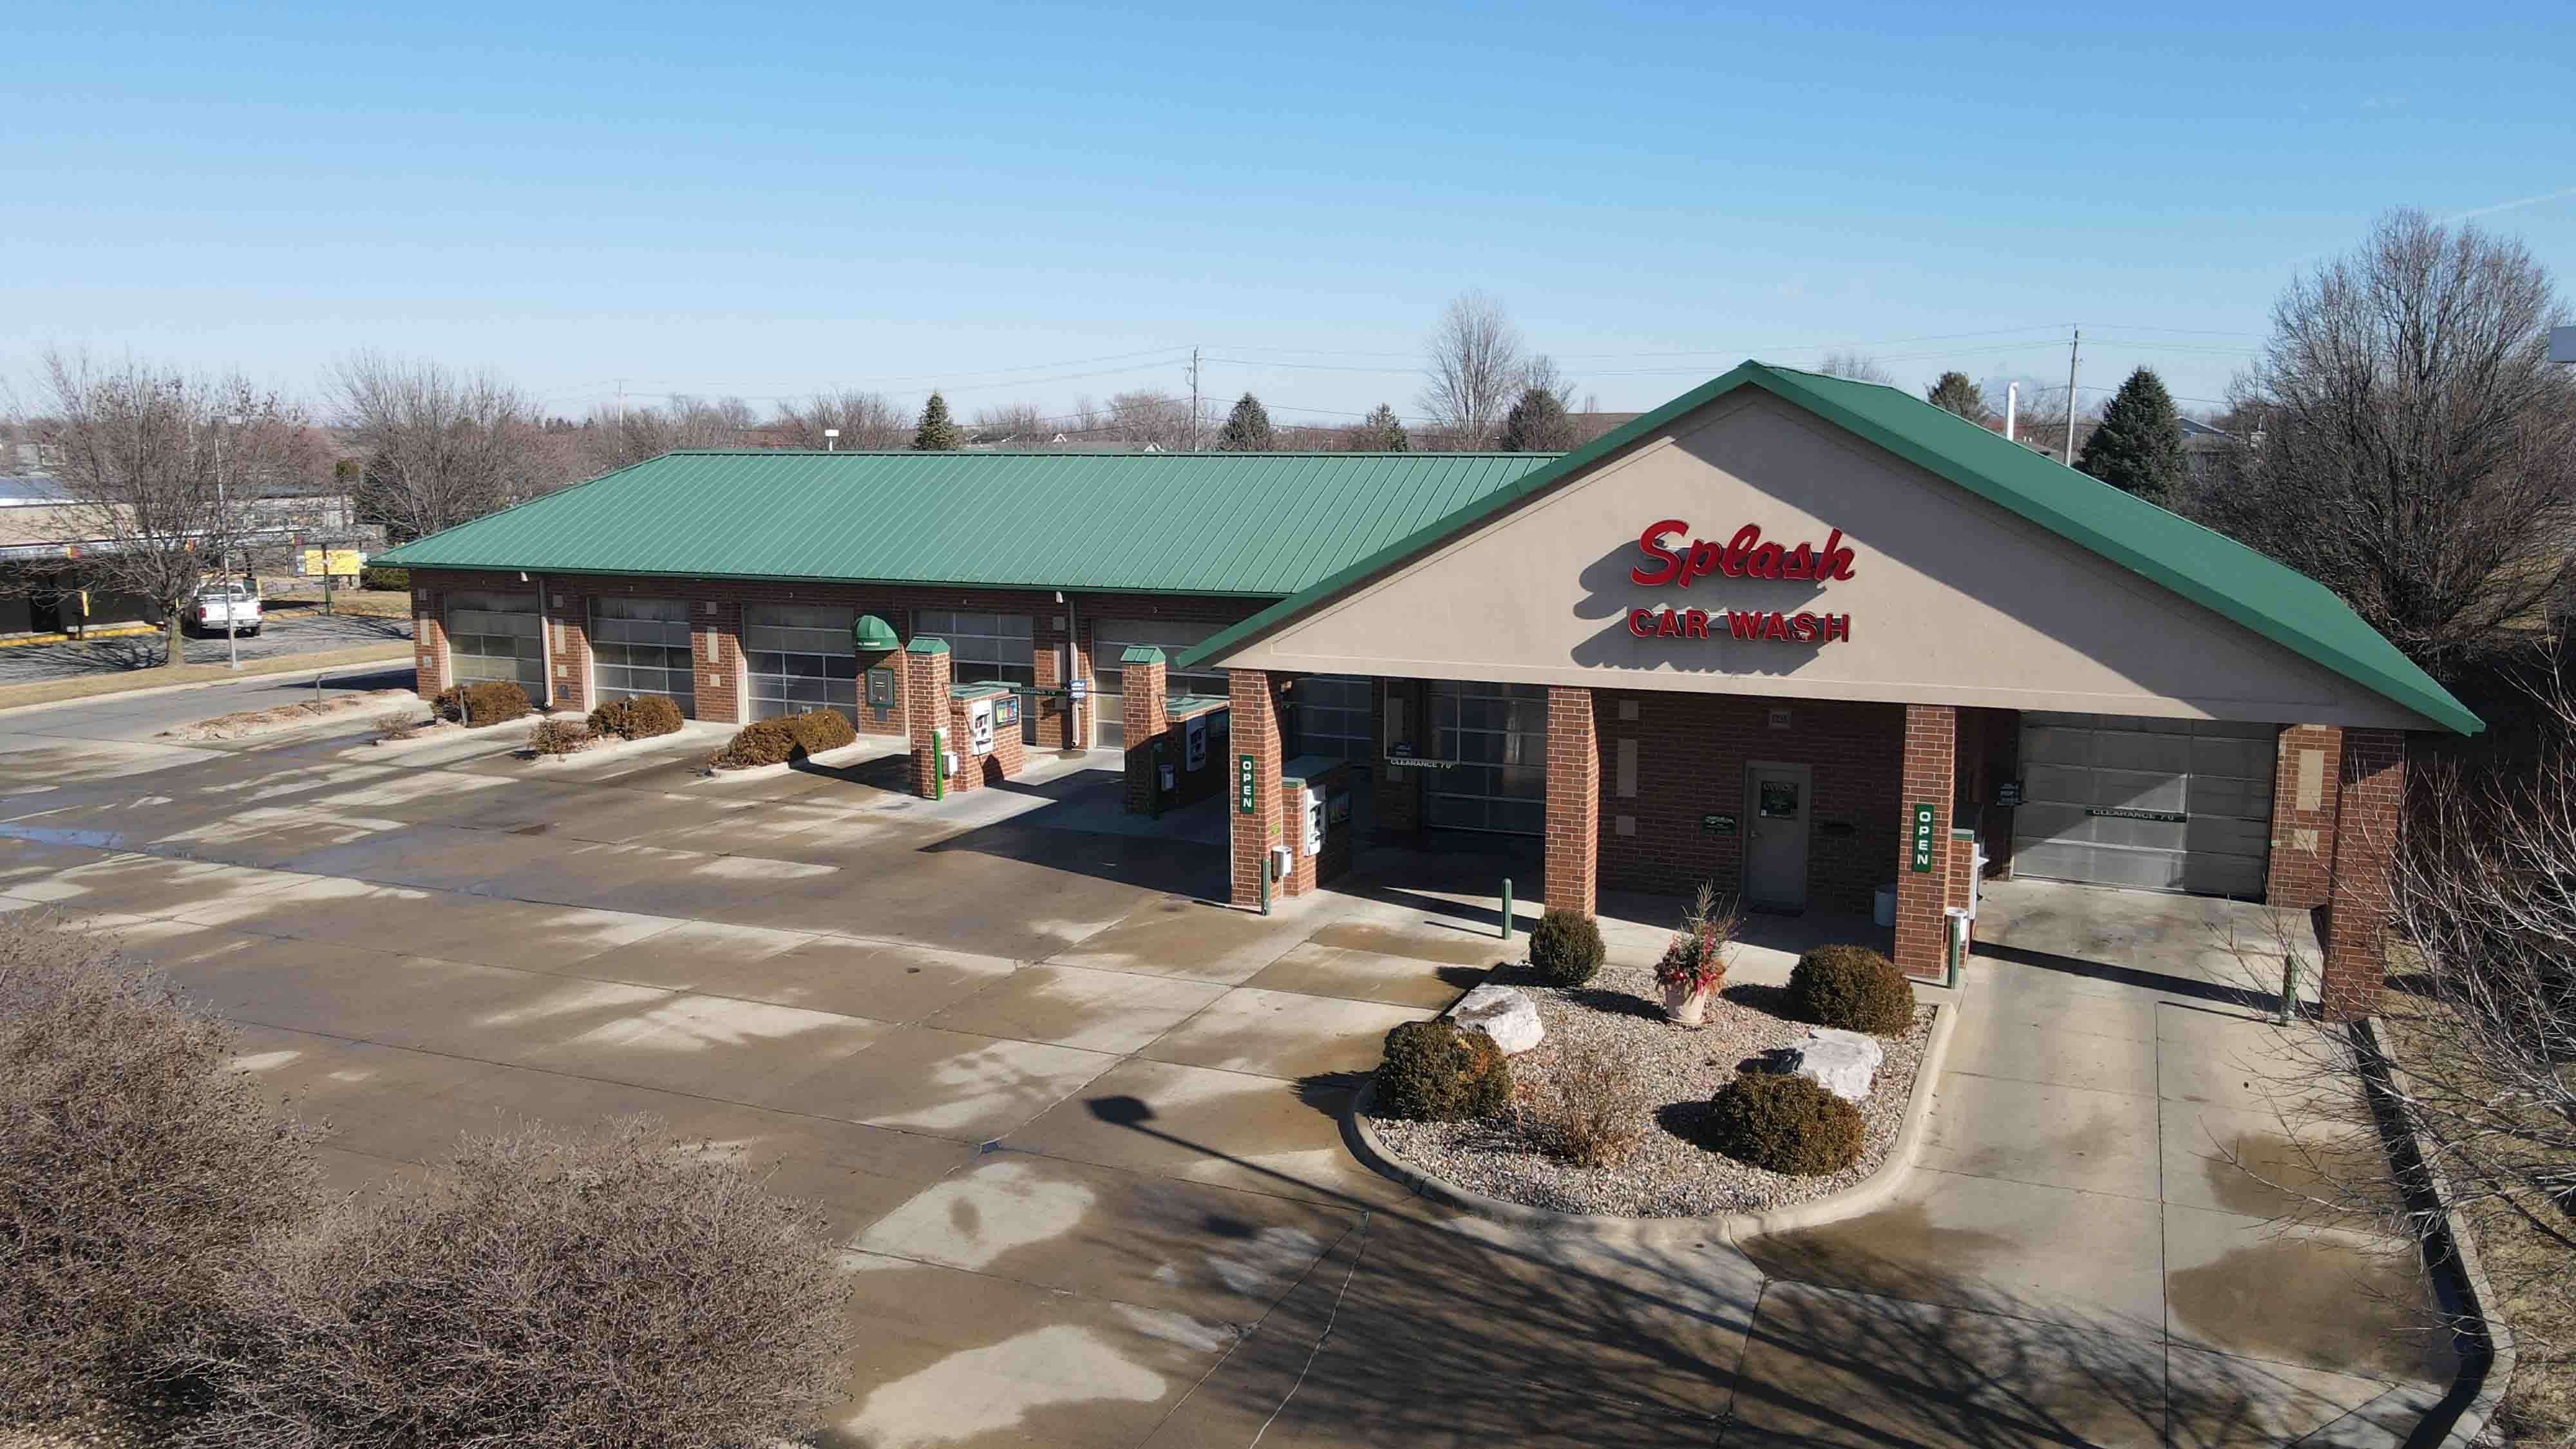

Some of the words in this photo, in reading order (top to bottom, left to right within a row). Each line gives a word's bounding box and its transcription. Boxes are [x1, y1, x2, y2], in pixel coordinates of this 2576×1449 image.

[1631, 520, 1855, 587] Splash
[1628, 609, 1710, 639] CAR
[1727, 611, 1850, 642] WASH
[1242, 761, 1252, 808] OPEN
[1917, 811, 1931, 865] OPEN
